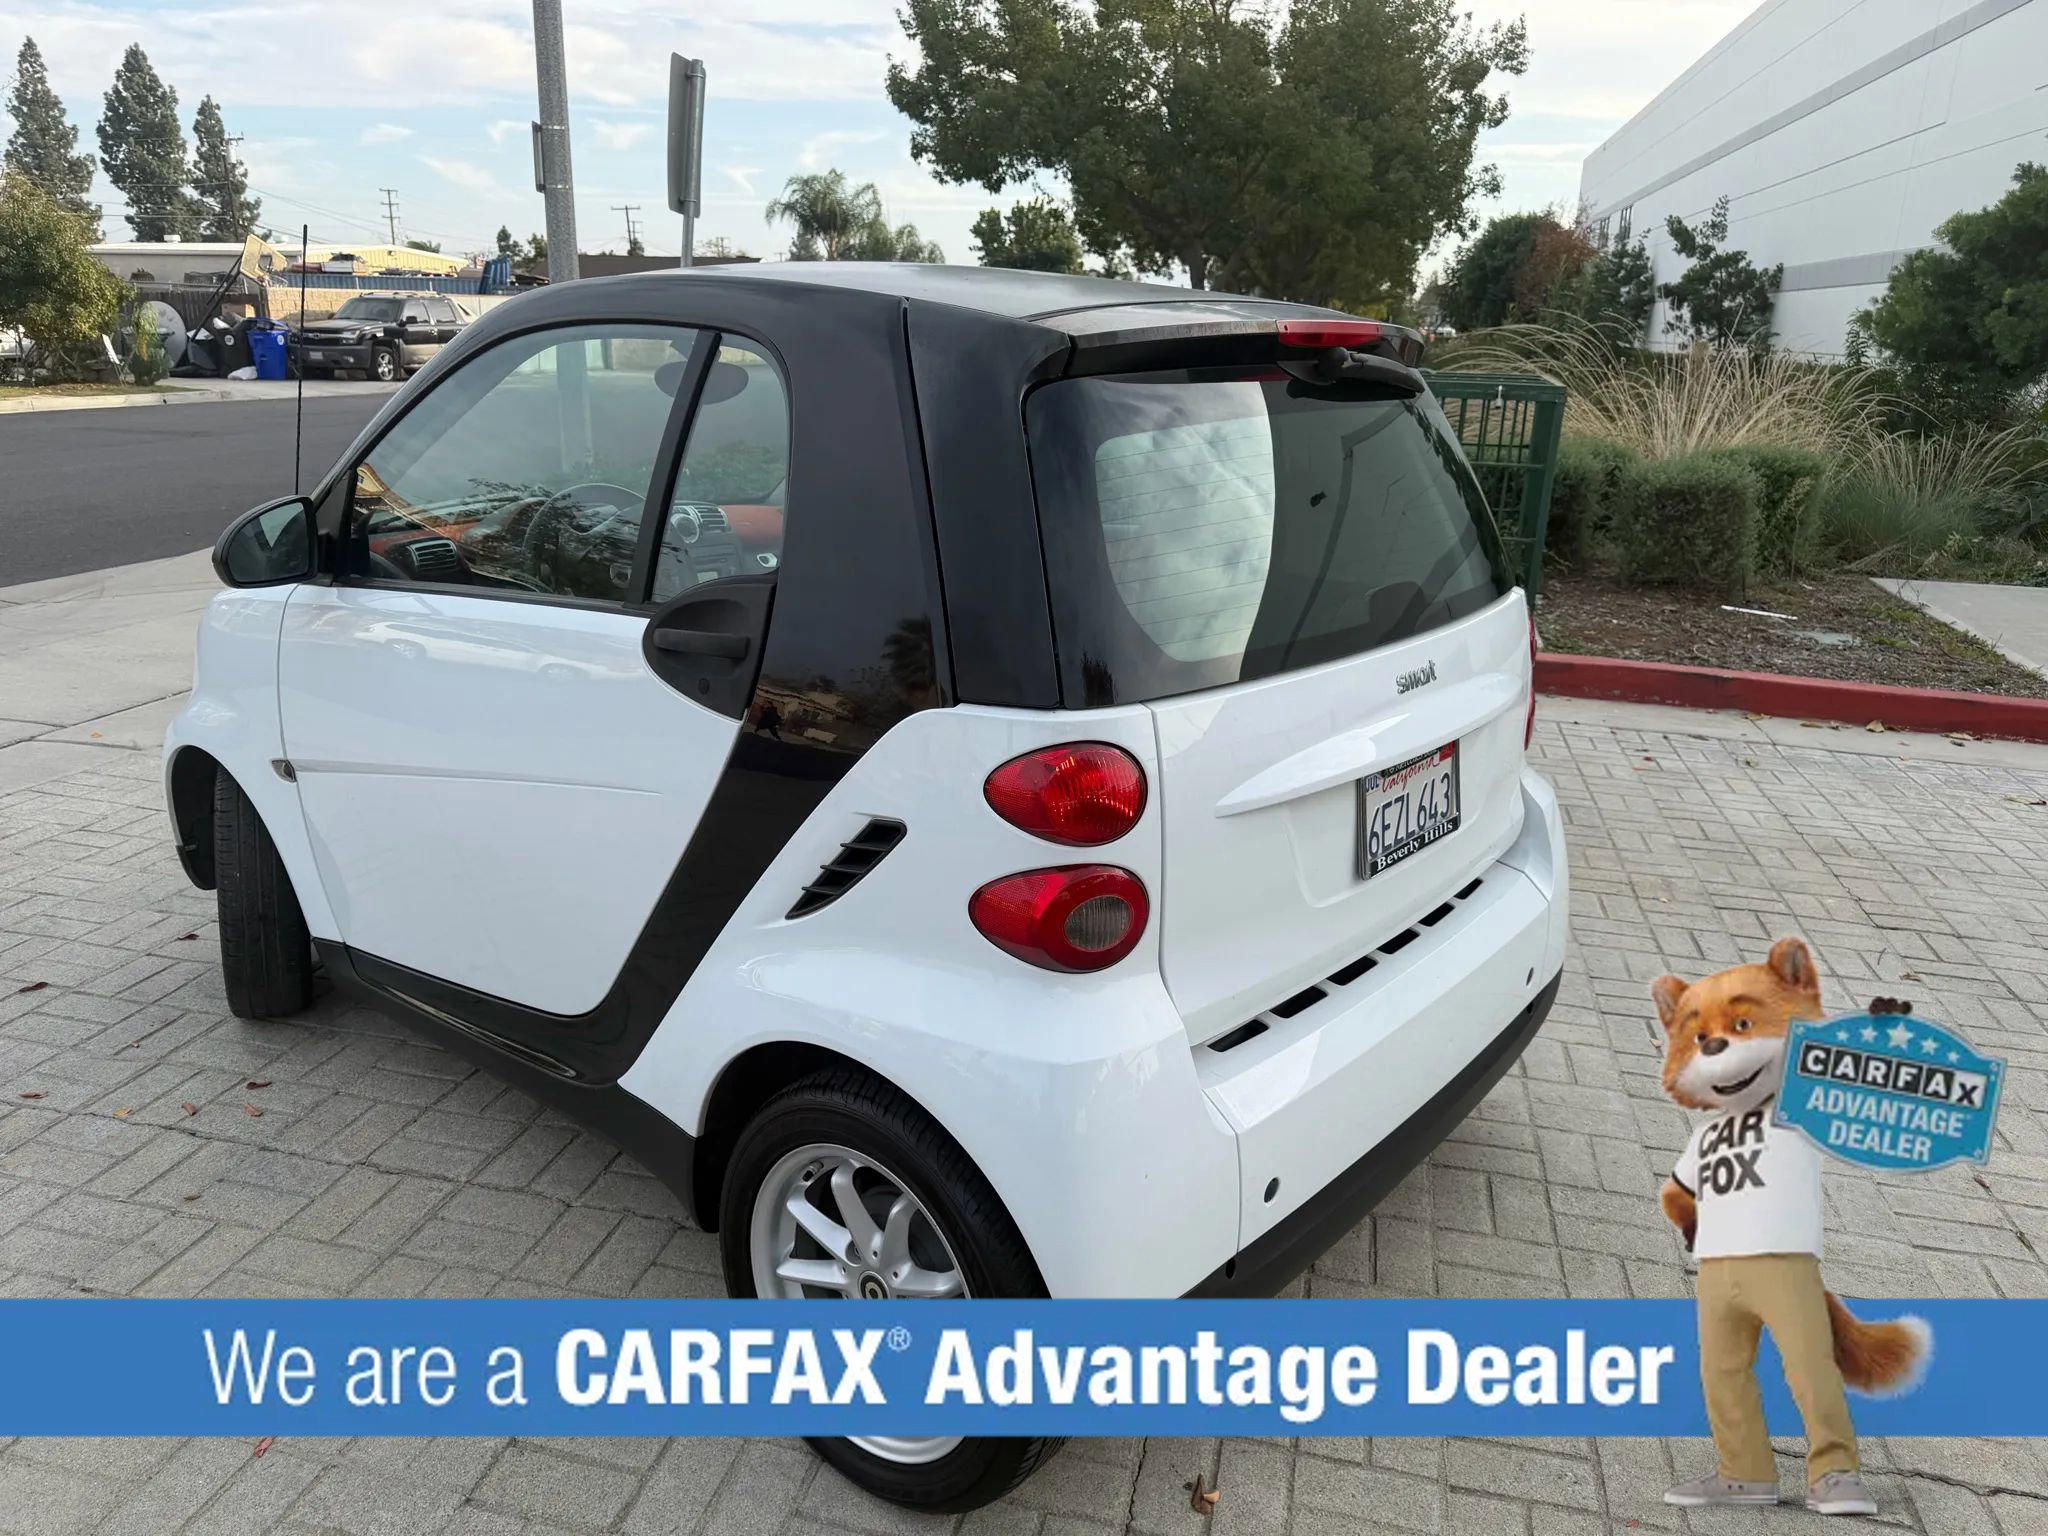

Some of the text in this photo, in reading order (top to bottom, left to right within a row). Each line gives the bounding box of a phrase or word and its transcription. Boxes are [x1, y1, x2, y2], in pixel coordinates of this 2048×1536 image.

[1396, 660, 1437, 694] smart
[1366, 775, 1380, 793] JUL
[1382, 755, 1440, 793] California
[1368, 772, 1451, 859] 6EZL643
[1376, 820, 1453, 872] Beverly Hills
